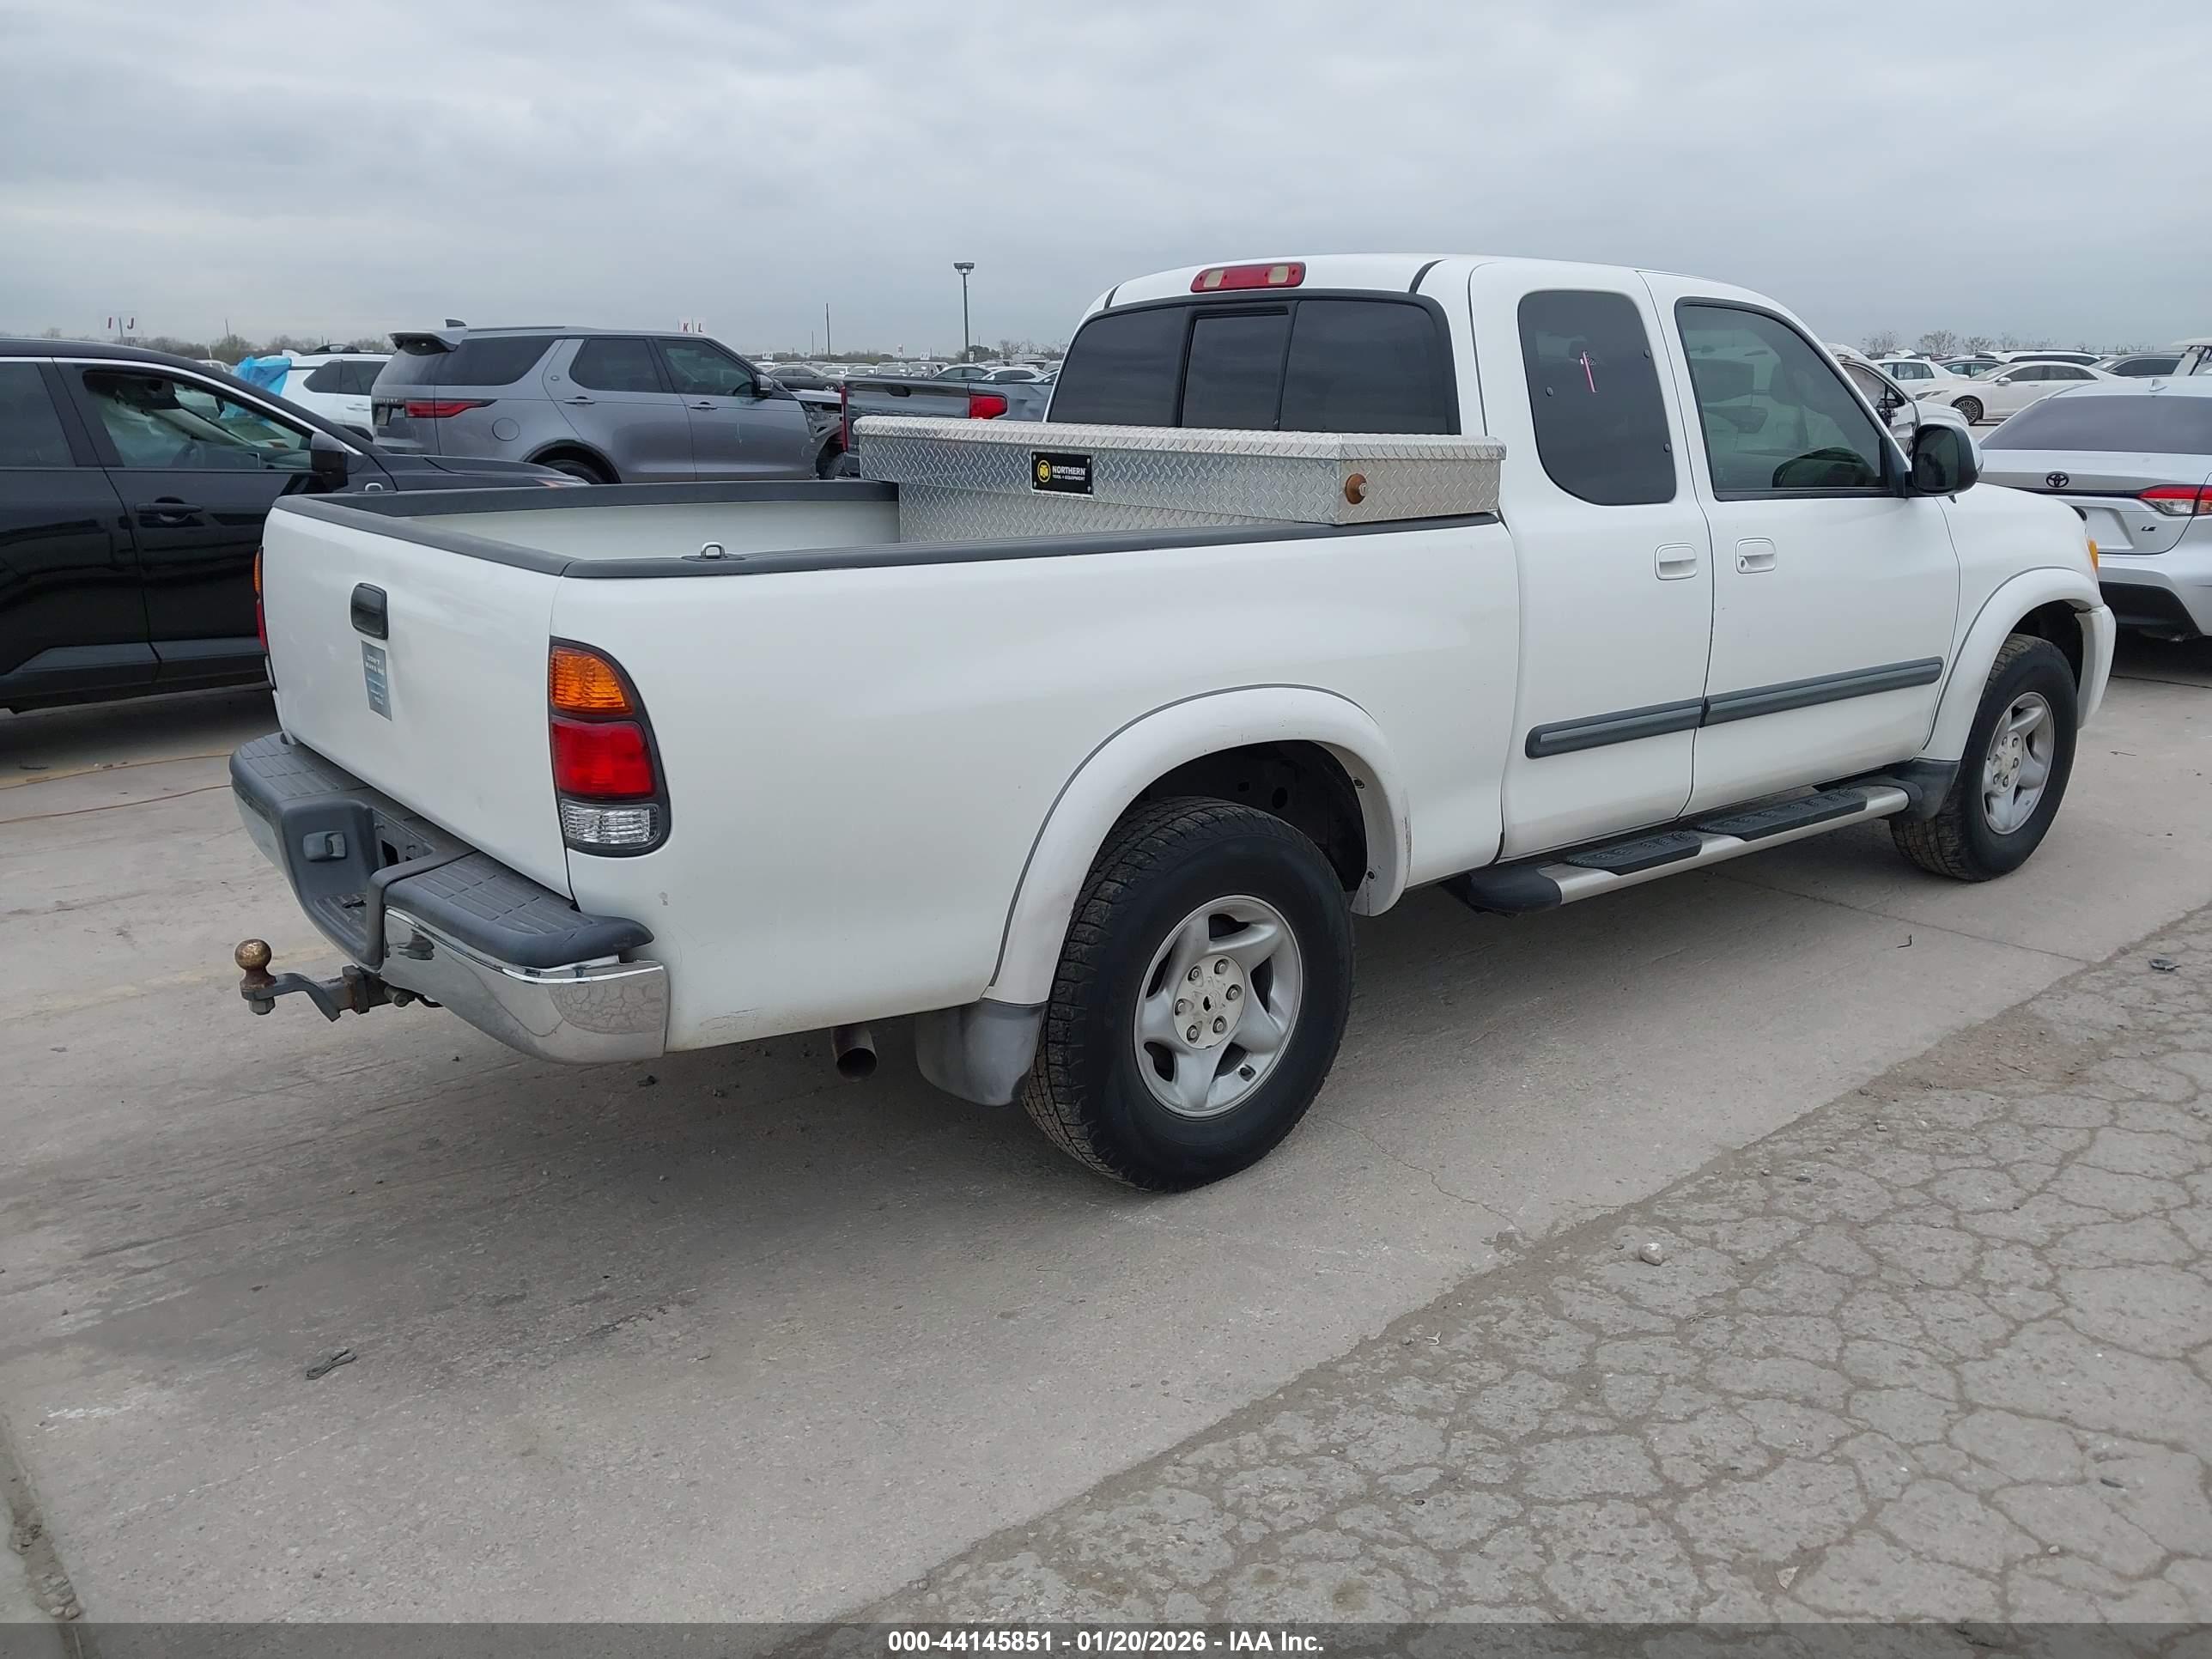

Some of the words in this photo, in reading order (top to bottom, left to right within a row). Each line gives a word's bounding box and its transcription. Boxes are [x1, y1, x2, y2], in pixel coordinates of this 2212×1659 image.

[126, 317, 134, 330] J
[683, 322, 688, 332] K
[697, 322, 703, 333] L
[1052, 465, 1085, 476] NORTHERN
